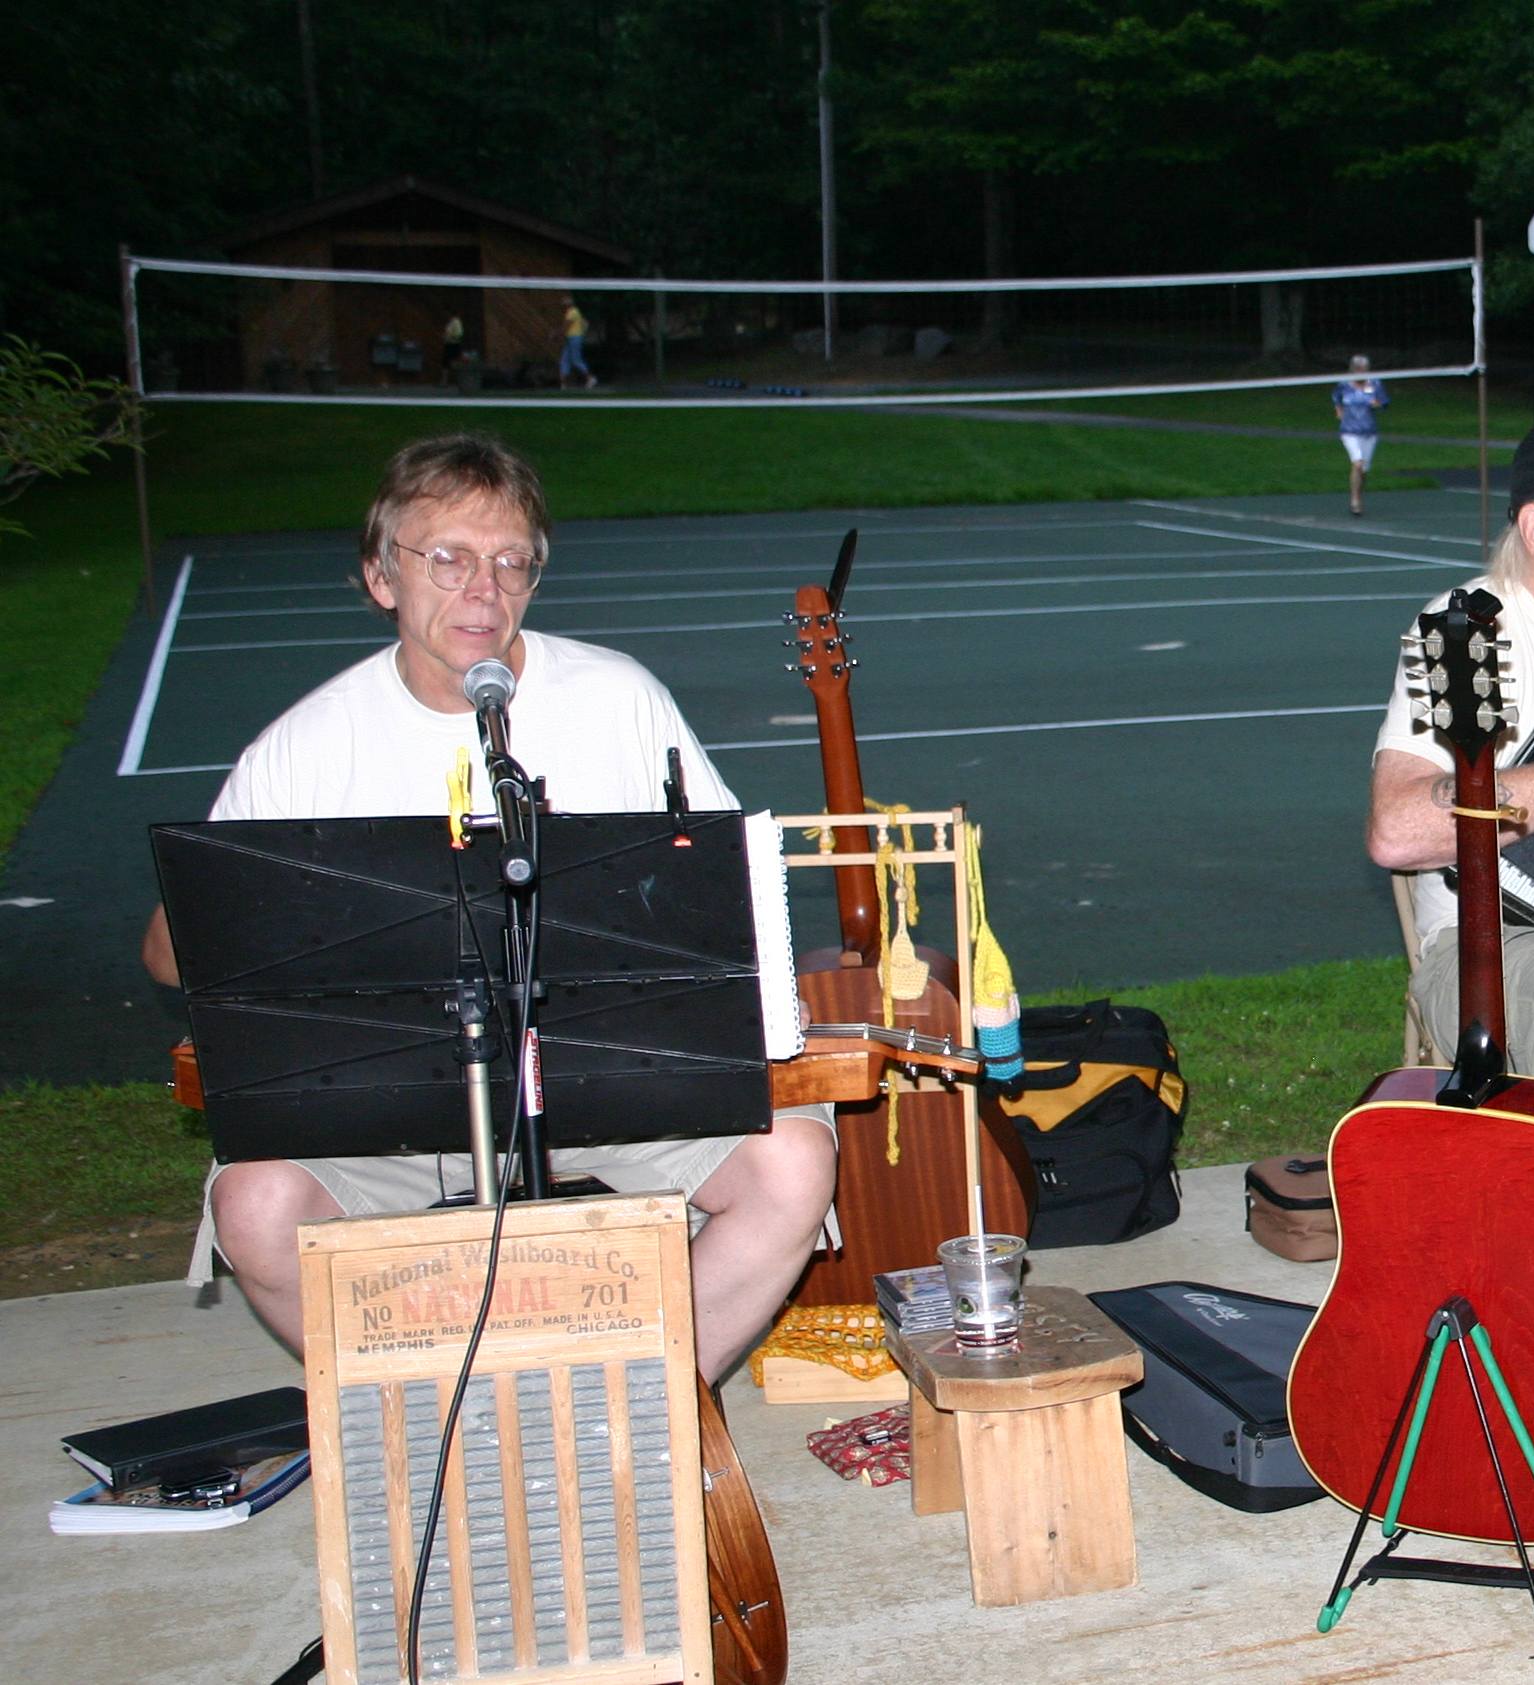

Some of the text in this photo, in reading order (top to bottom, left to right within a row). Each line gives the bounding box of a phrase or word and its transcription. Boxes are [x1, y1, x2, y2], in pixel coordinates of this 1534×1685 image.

[351, 1240, 640, 1307] National Wshboard Co.
[581, 1281, 630, 1309] 701
[363, 1331, 397, 1344] TRADE
[403, 1328, 435, 1340] MARK
[542, 1315, 573, 1326] MADE
[577, 1312, 589, 1323] IN
[566, 1317, 643, 1335] CHICAGO
[357, 1338, 435, 1355] MEMPHIS
